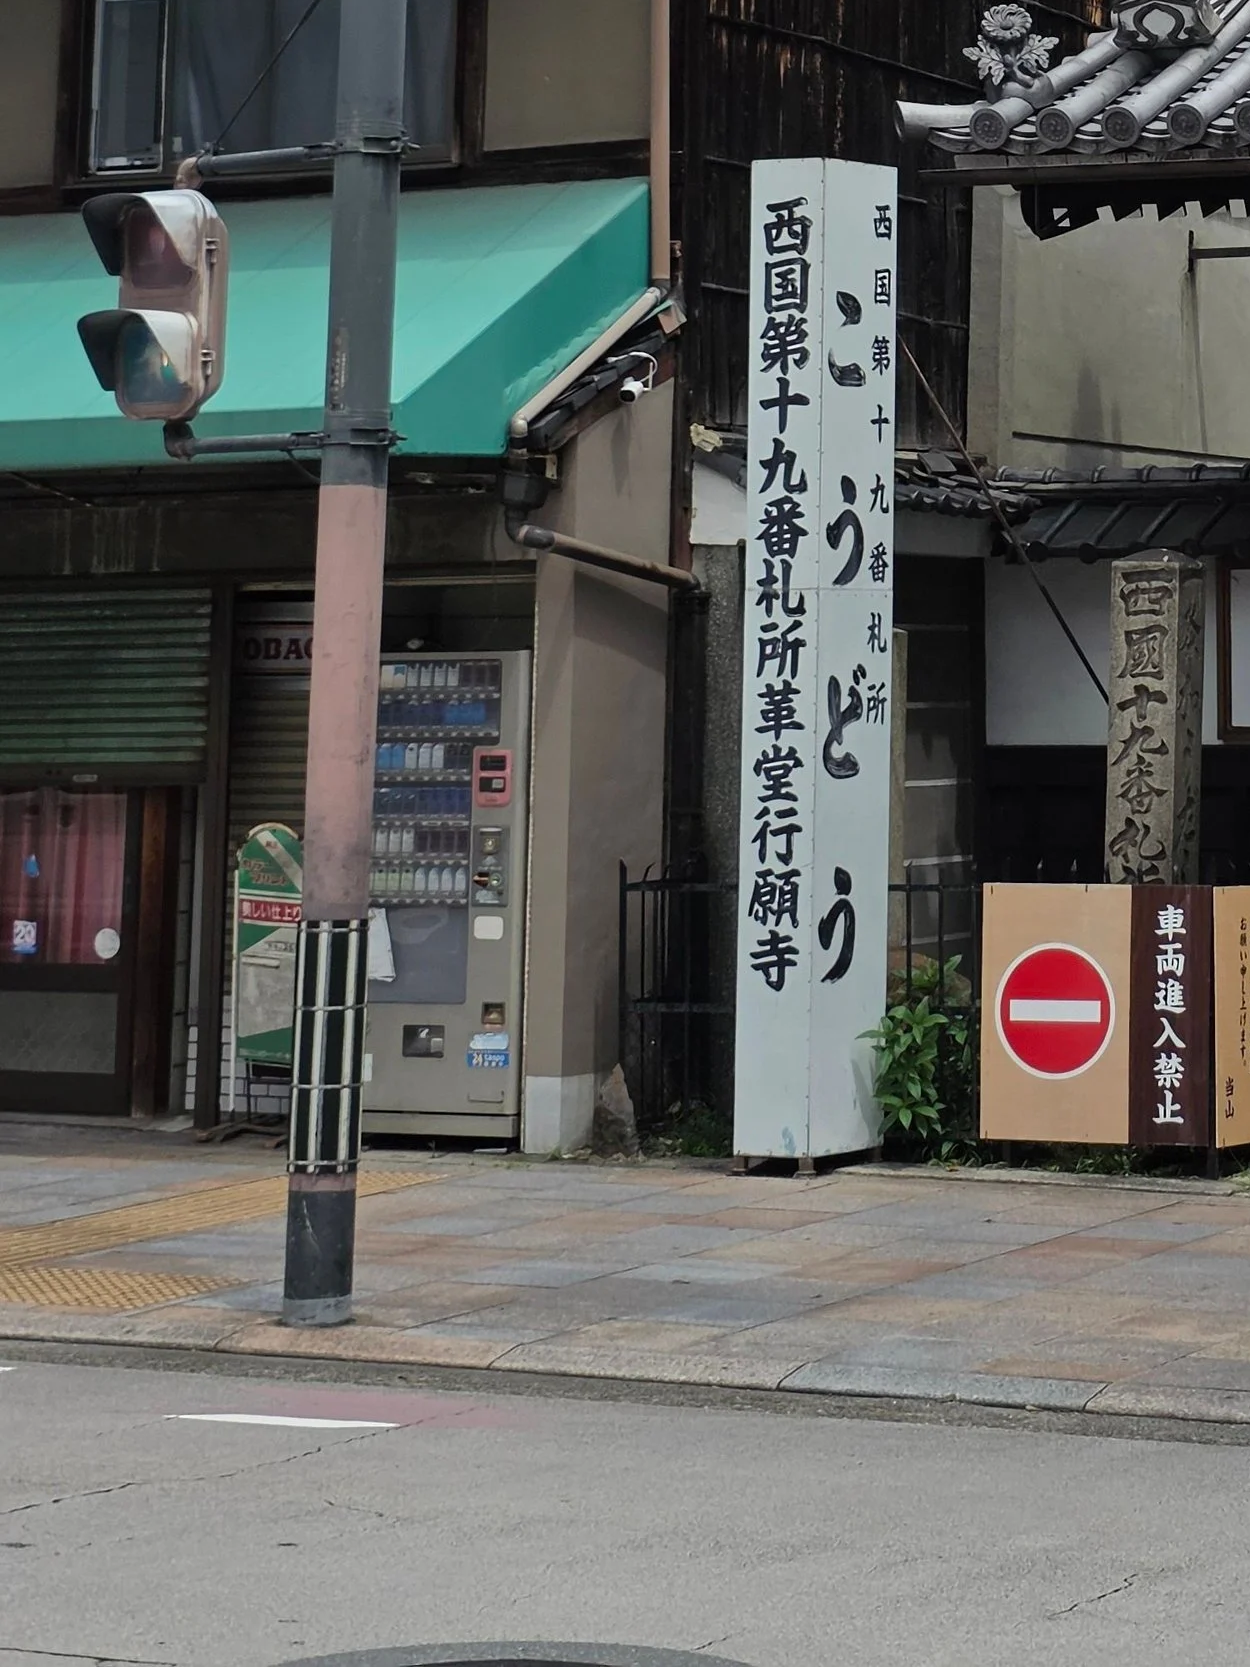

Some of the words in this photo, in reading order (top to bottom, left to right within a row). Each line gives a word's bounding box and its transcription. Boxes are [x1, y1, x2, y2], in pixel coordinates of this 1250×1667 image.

[748, 197, 814, 992] 西国第十九番札所革堂行願寺
[818, 290, 867, 984] こうどう
[867, 205, 893, 726] 西国第十九番札所
[1153, 904, 1187, 1125] 車両進入禁止
[1225, 1076, 1235, 1119] 当山
